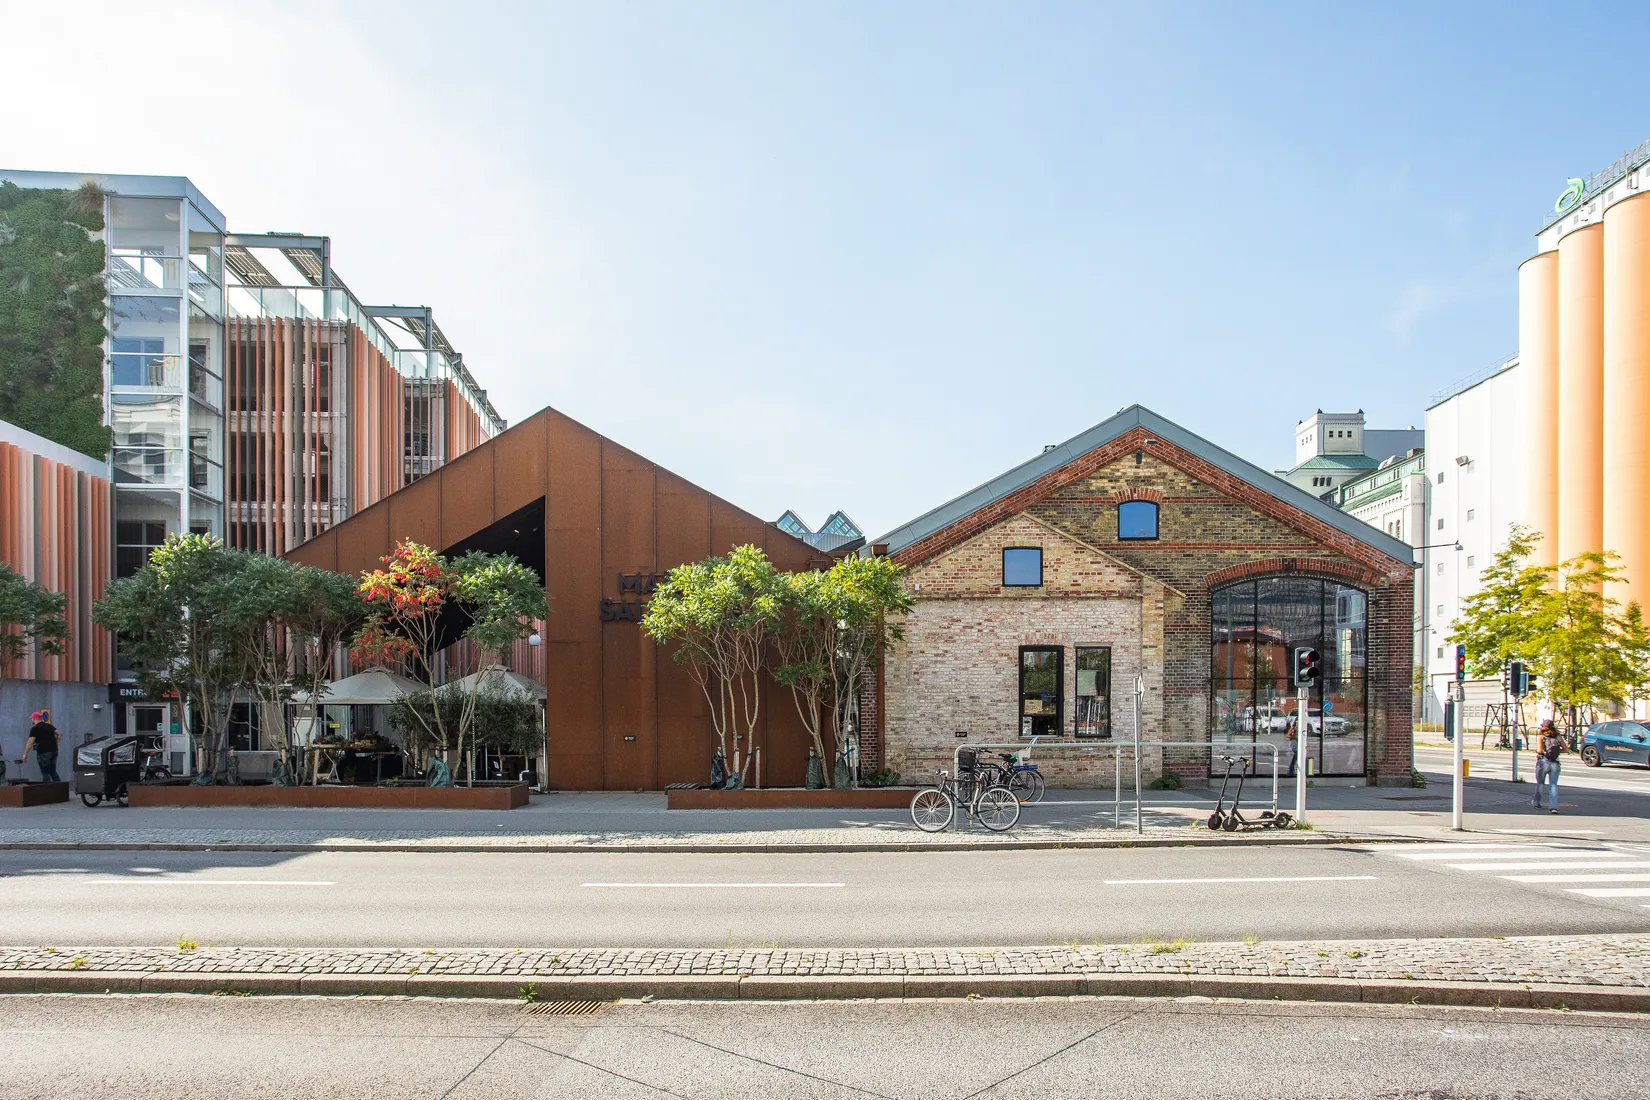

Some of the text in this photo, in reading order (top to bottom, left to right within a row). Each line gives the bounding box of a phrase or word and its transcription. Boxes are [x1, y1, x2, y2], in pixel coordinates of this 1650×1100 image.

[1589, 138, 1650, 190] Lantm
[165, 260, 176, 281] 11
[618, 572, 671, 594] MA
